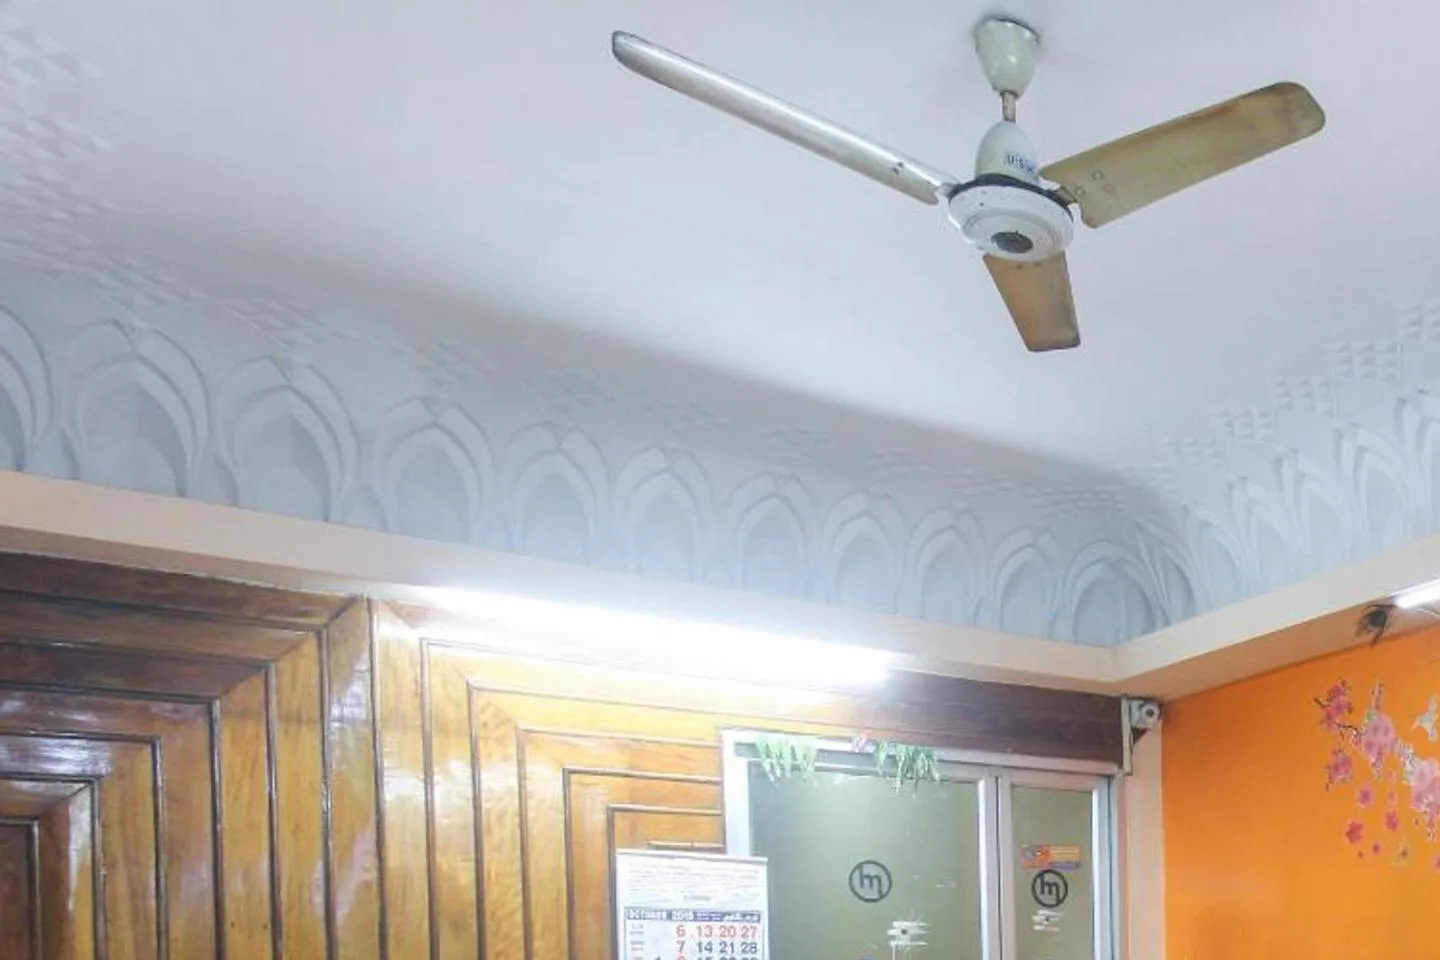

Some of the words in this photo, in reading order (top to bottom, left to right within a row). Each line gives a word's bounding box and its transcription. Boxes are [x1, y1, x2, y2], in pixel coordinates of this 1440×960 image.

[676, 925, 686, 937] 6
[698, 925, 713, 937] 13
[720, 925, 737, 938] 20
[740, 926, 757, 938] 27
[676, 941, 685, 953] 7
[697, 941, 713, 953] 14
[720, 941, 735, 953] 21
[740, 941, 757, 954] 28
